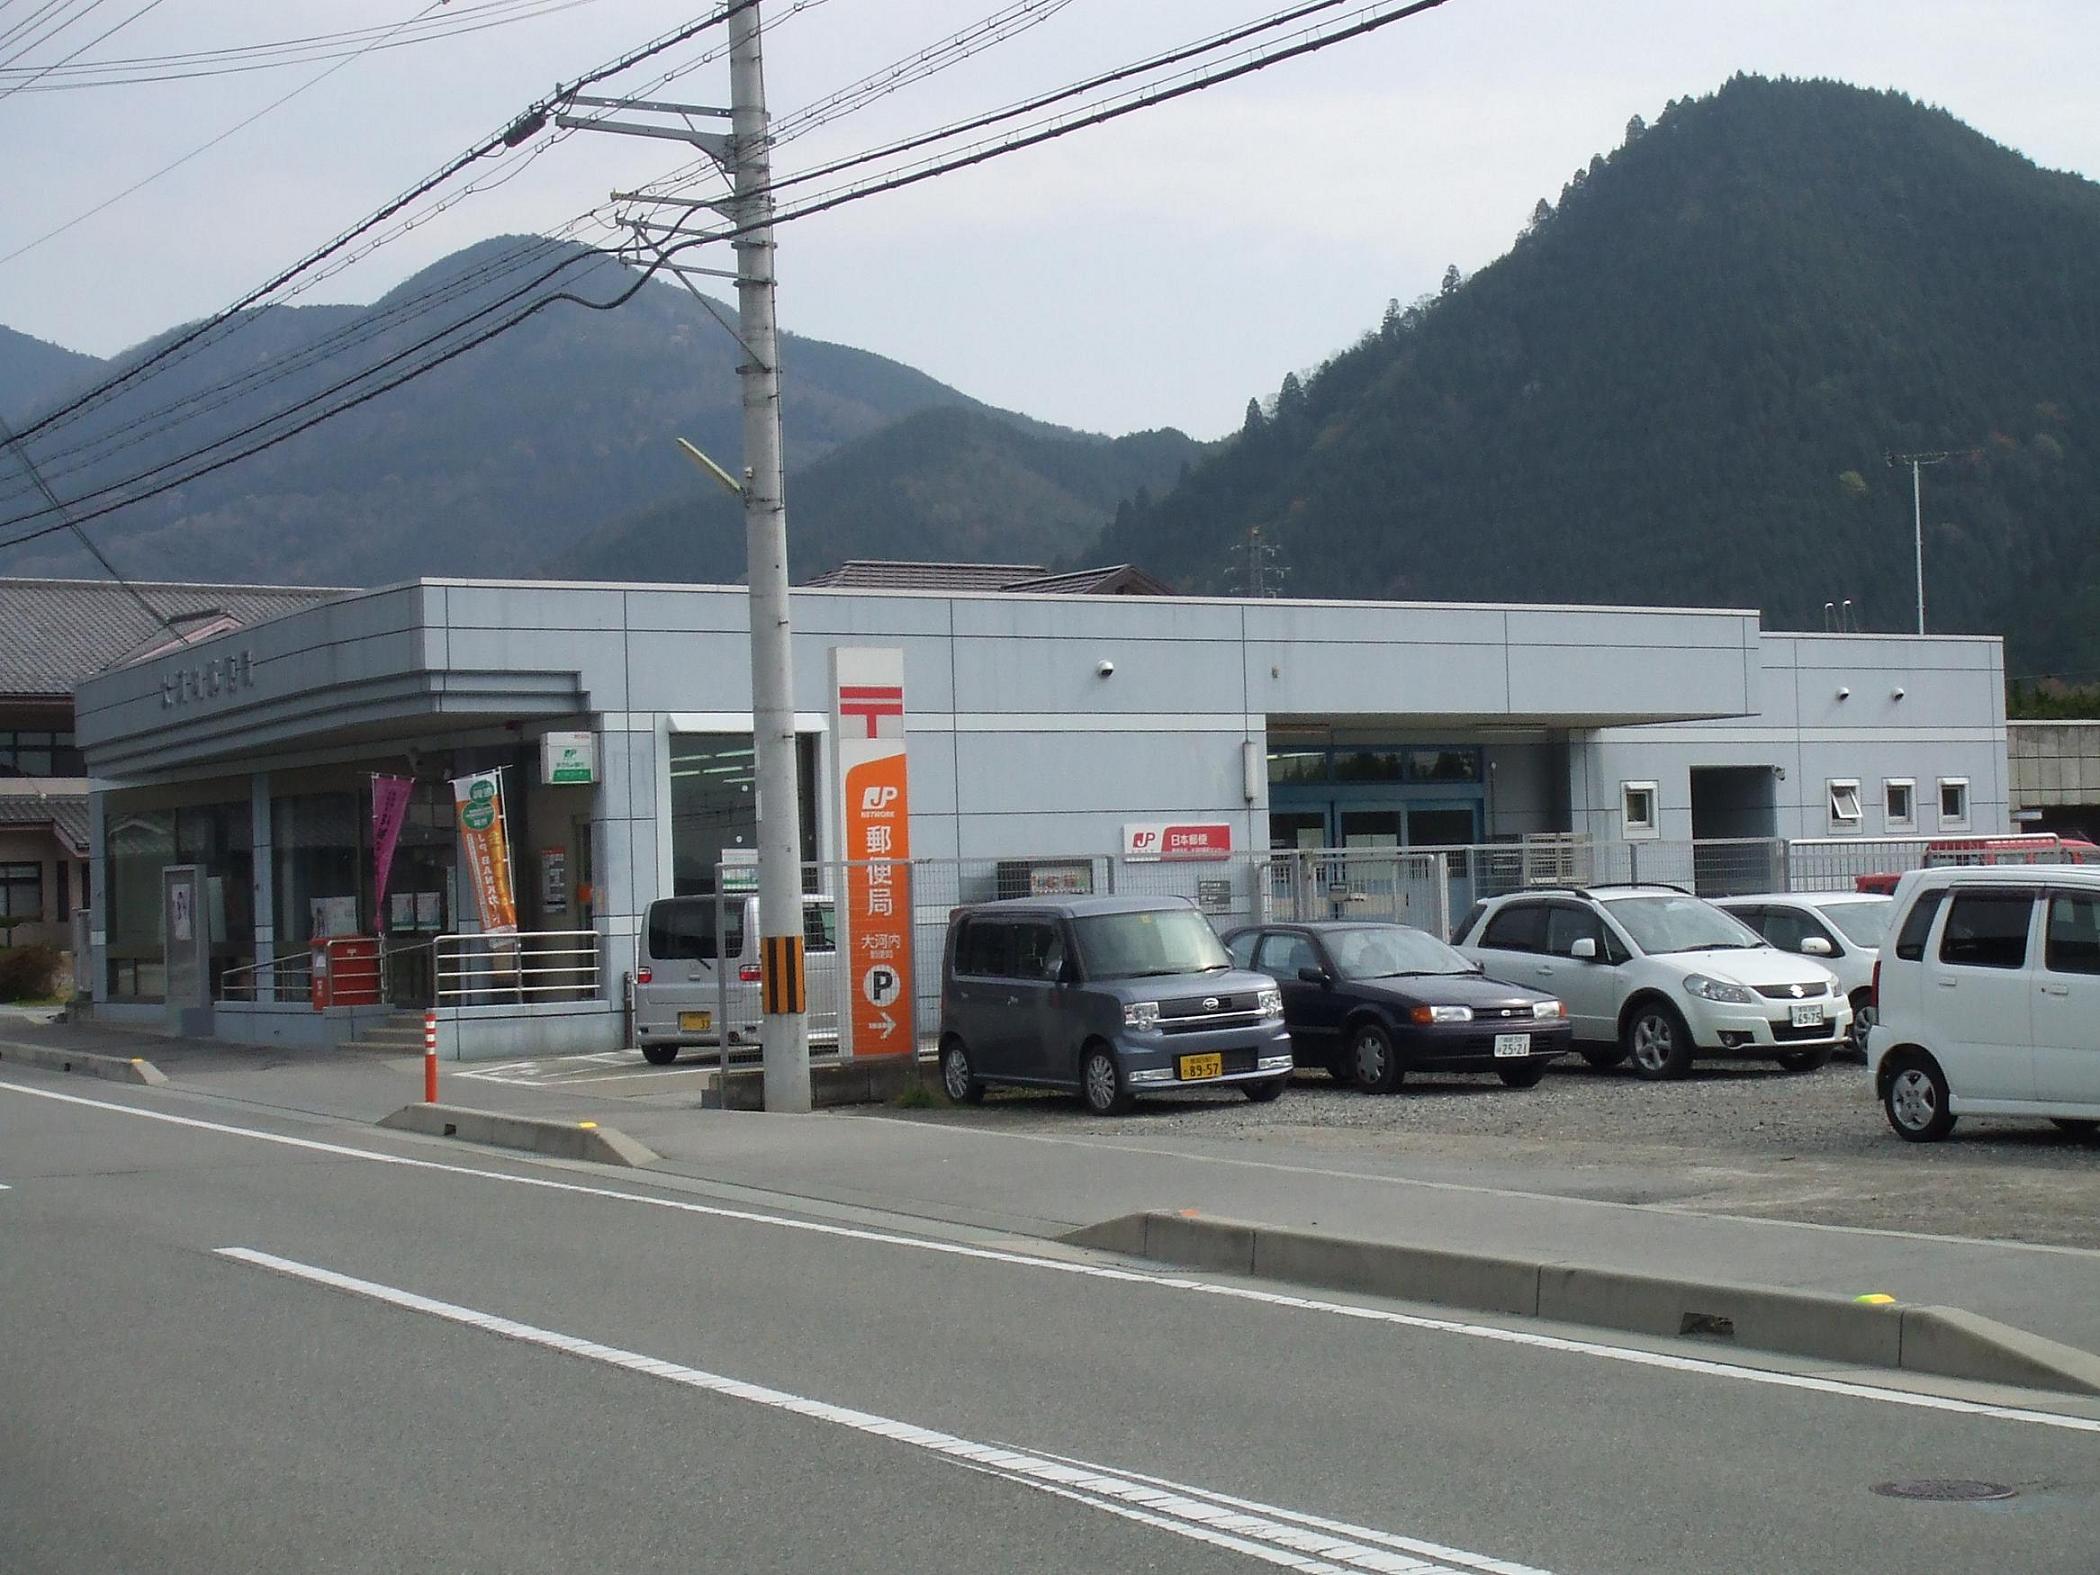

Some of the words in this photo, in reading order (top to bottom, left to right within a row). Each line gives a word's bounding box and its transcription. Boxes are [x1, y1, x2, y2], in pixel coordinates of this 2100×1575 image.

[862, 786, 898, 809] JP
[1132, 832, 1156, 848] JP
[1170, 833, 1208, 847] 日本郵便
[866, 825, 892, 916] 郵便局
[861, 933, 901, 949] 大河内
[873, 971, 893, 1000] P
[1189, 1062, 1219, 1077] 89-57
